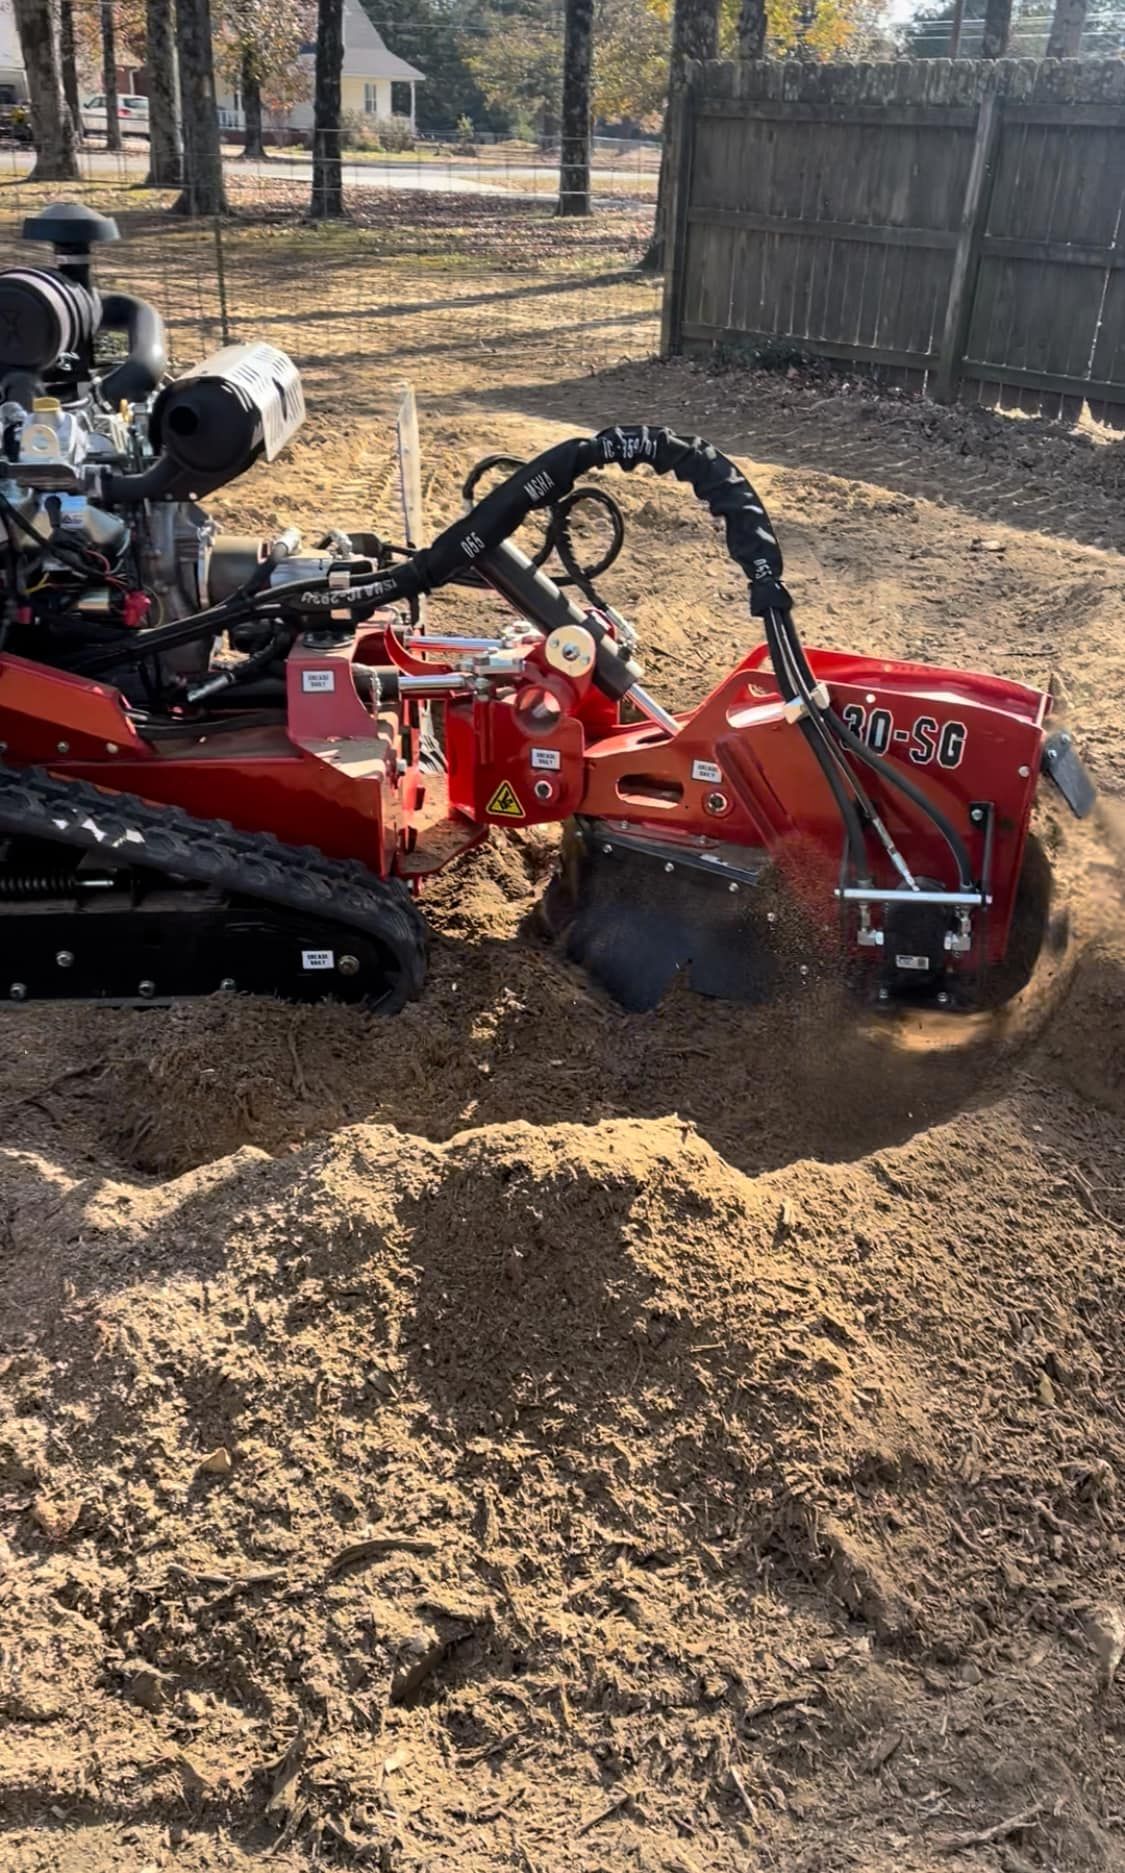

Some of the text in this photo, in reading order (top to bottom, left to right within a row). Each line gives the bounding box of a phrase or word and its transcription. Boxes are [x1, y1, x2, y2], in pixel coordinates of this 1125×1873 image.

[523, 471, 555, 501] MSHA
[461, 531, 486, 559] 055
[840, 703, 968, 770] 30-SG
